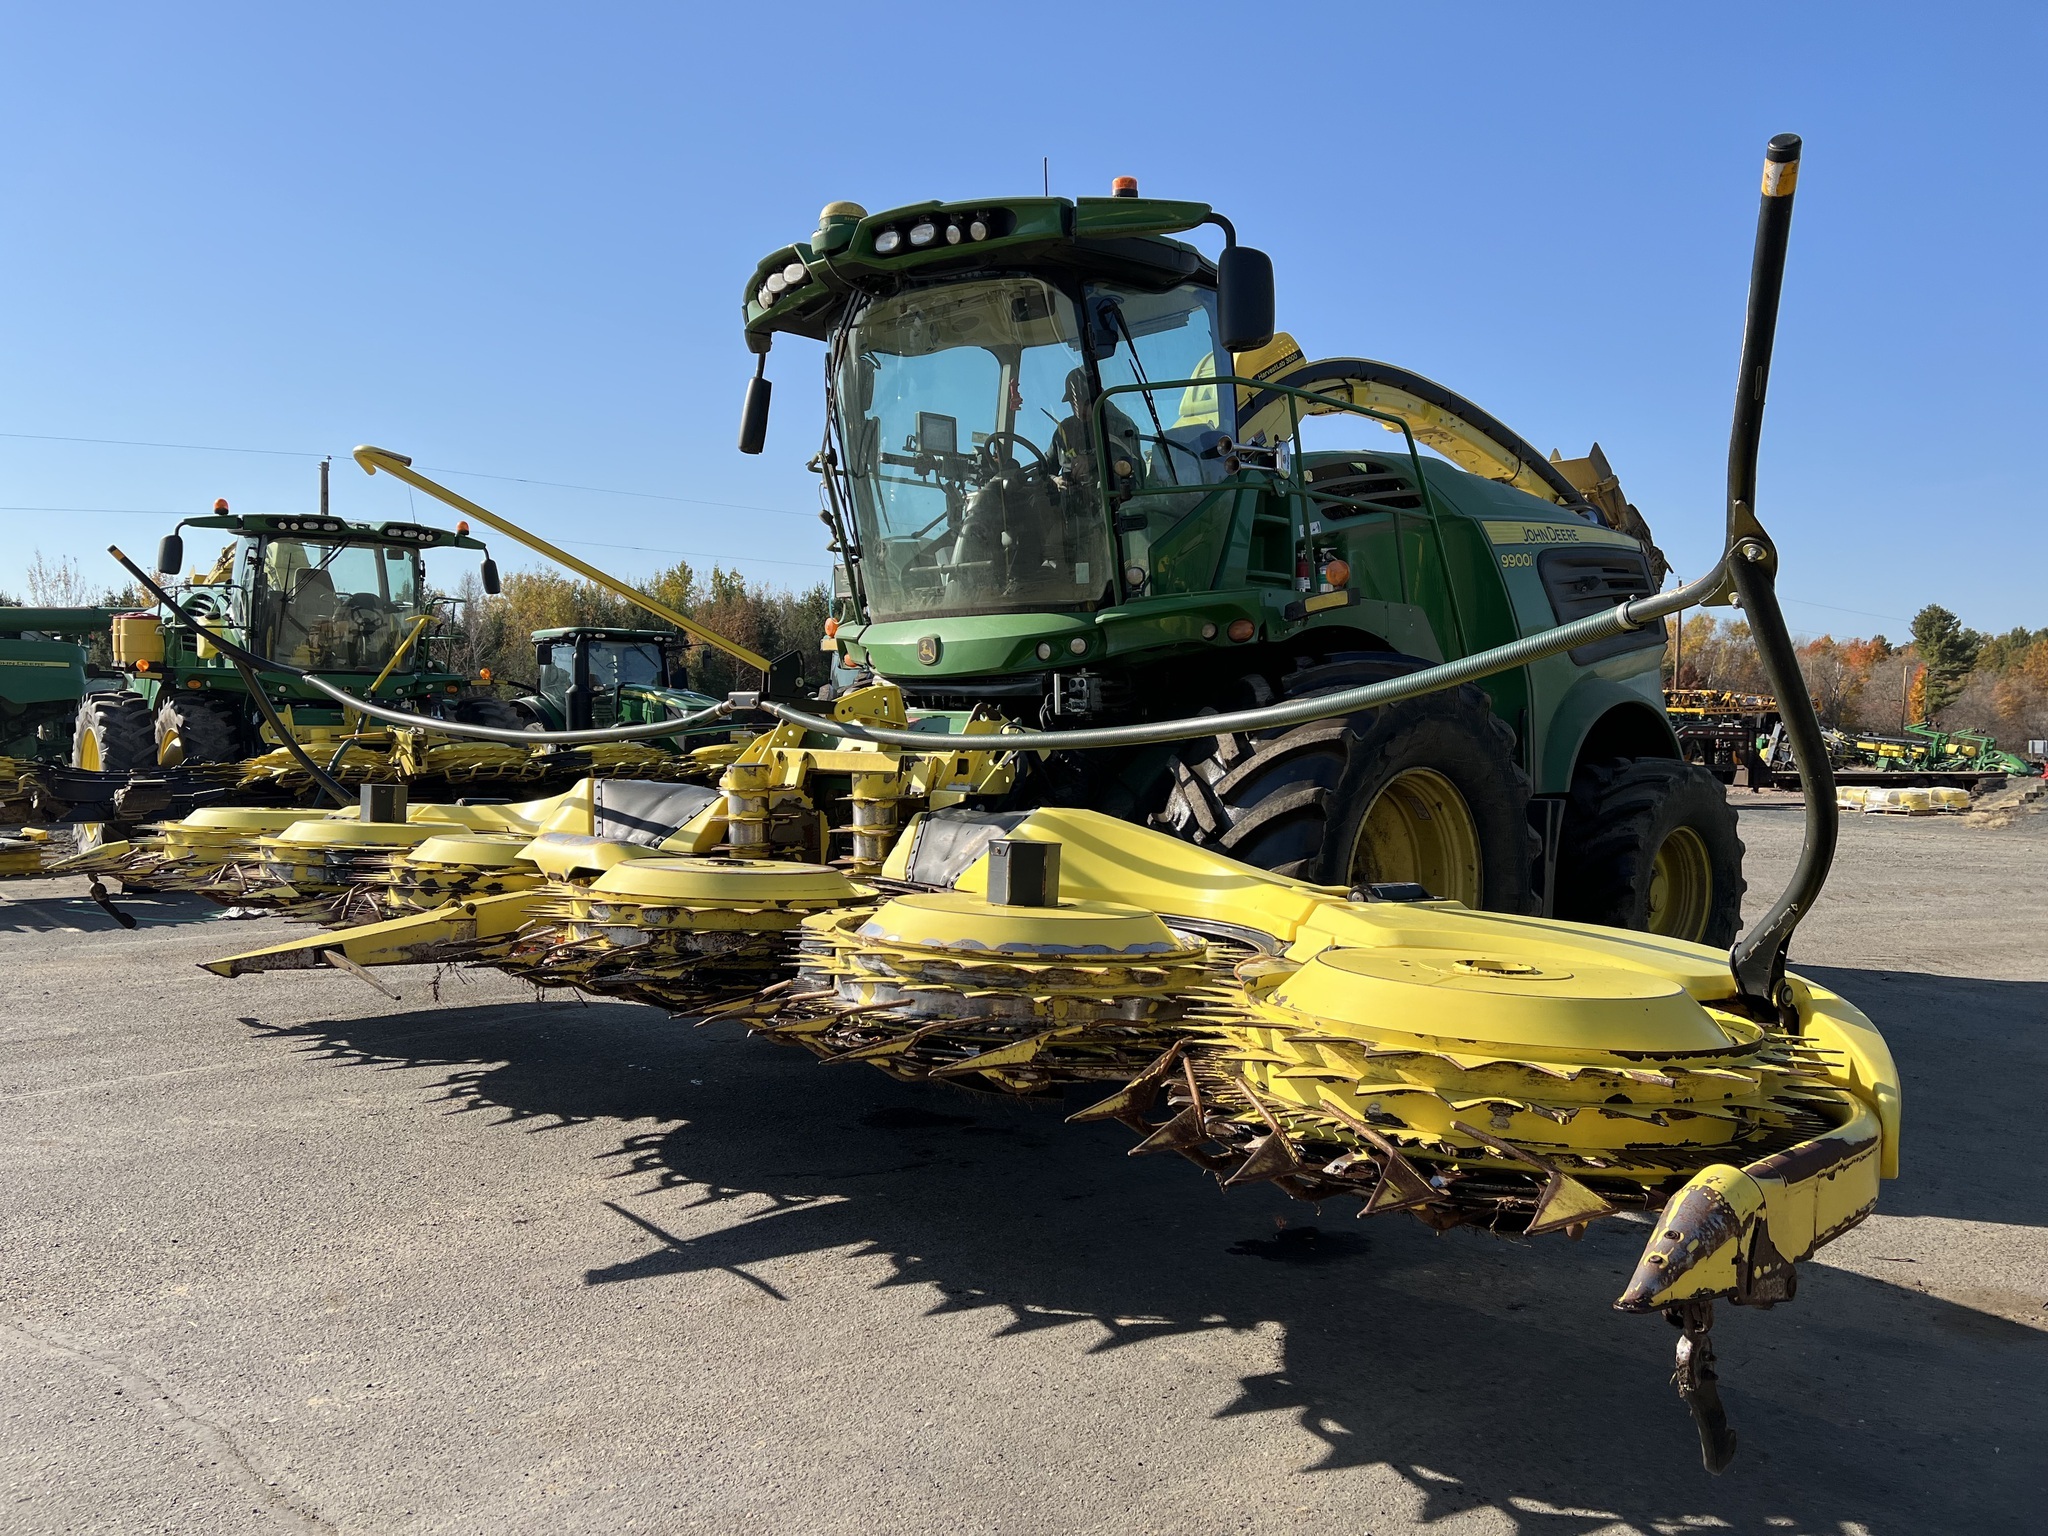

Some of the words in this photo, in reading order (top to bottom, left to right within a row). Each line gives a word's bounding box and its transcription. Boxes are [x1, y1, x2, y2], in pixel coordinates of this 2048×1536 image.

[1258, 361, 1285, 380] HarvestLab
[1286, 353, 1298, 365] 3000
[1501, 551, 1533, 568] 9900i
